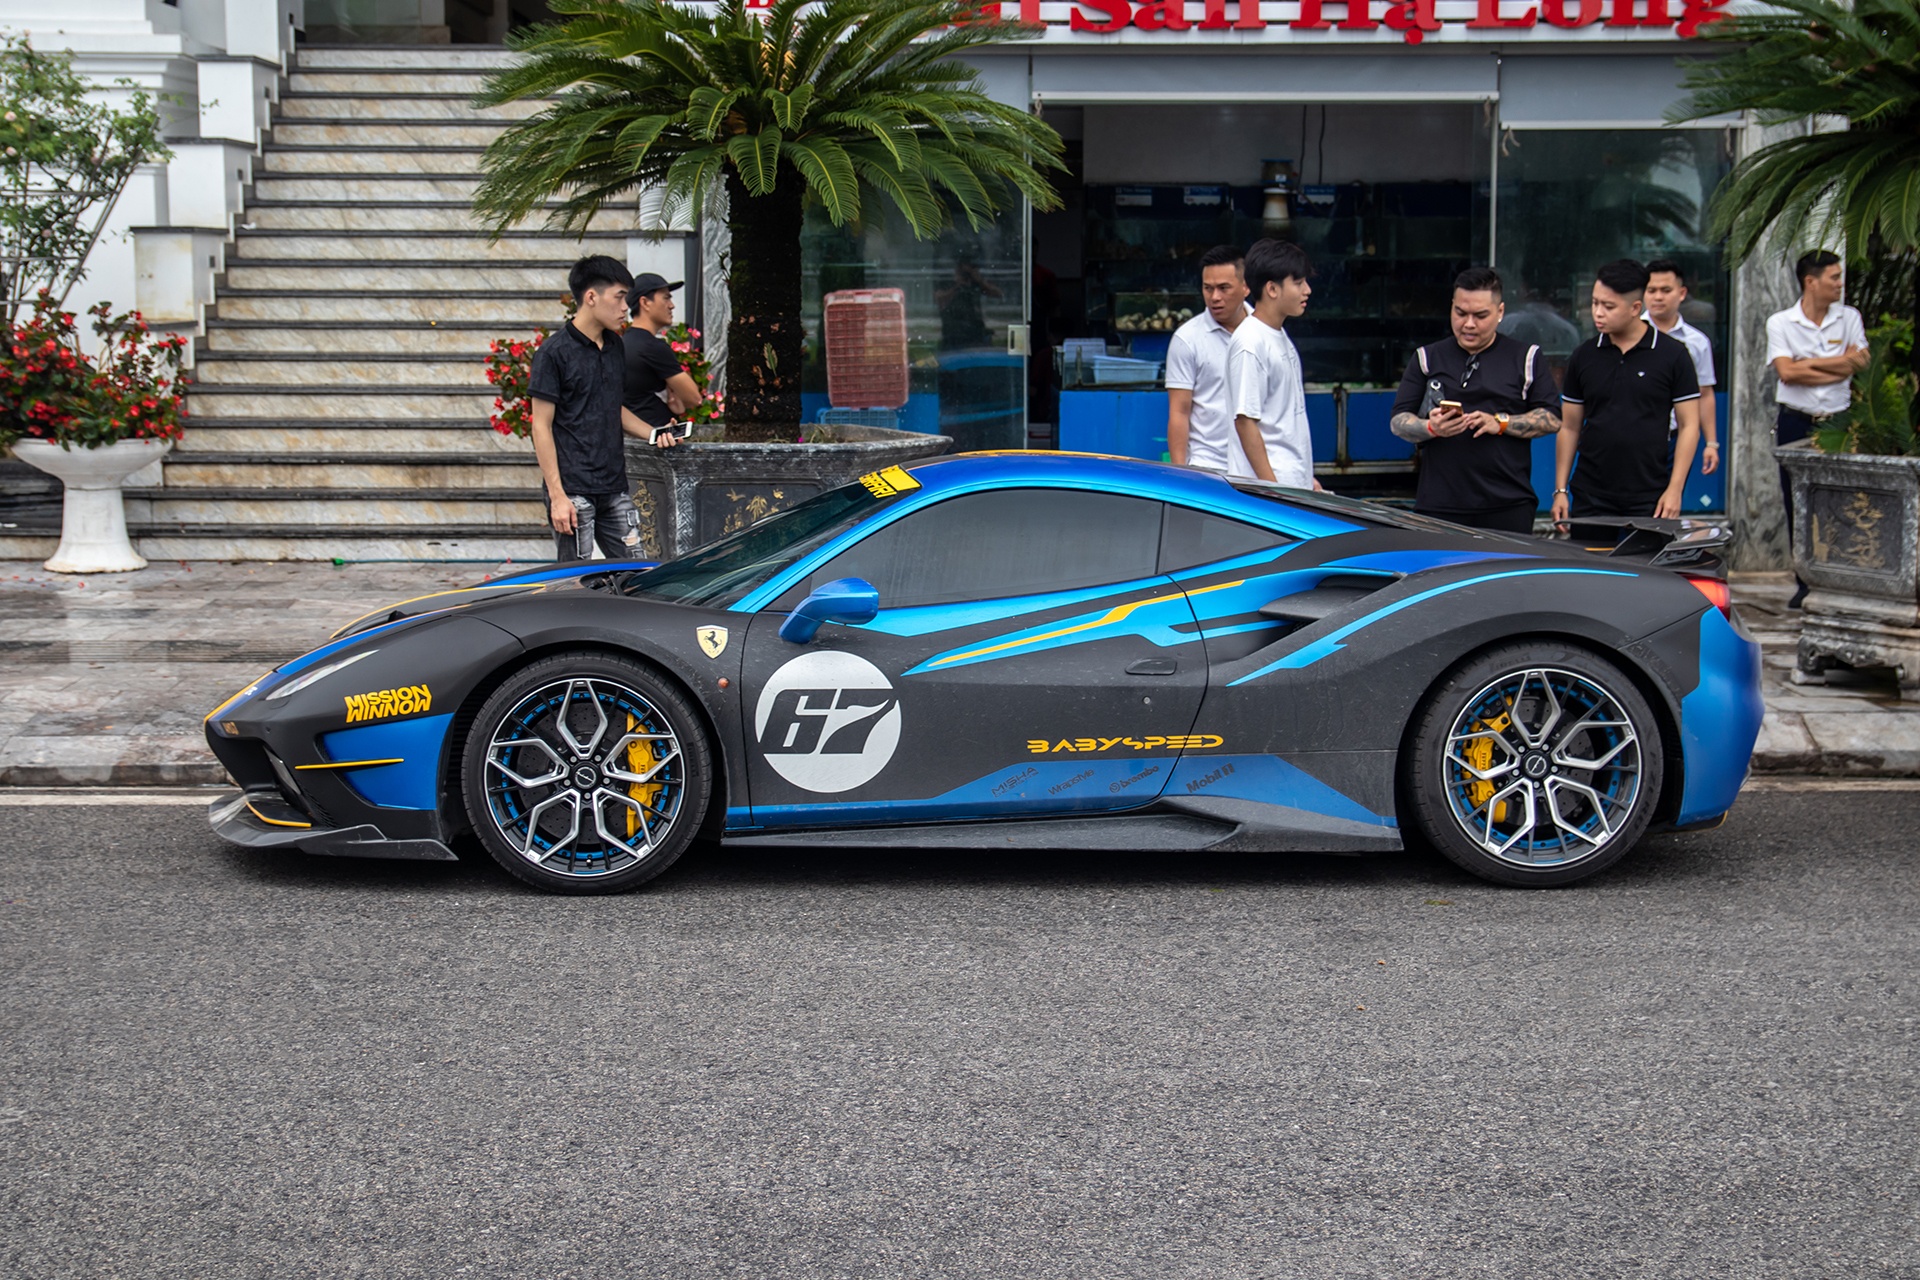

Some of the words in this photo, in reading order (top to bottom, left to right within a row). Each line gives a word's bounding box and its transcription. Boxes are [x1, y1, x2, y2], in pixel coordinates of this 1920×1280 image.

[344, 684, 432, 708] MISSION
[346, 698, 432, 723] WINNOW
[758, 688, 896, 754] 67
[1026, 734, 1224, 753] BABYSPEED
[991, 767, 1037, 796] MISHA
[1048, 769, 1094, 795] Wrapstyle
[1119, 765, 1159, 788] brembo
[1186, 769, 1222, 793] Mobil
